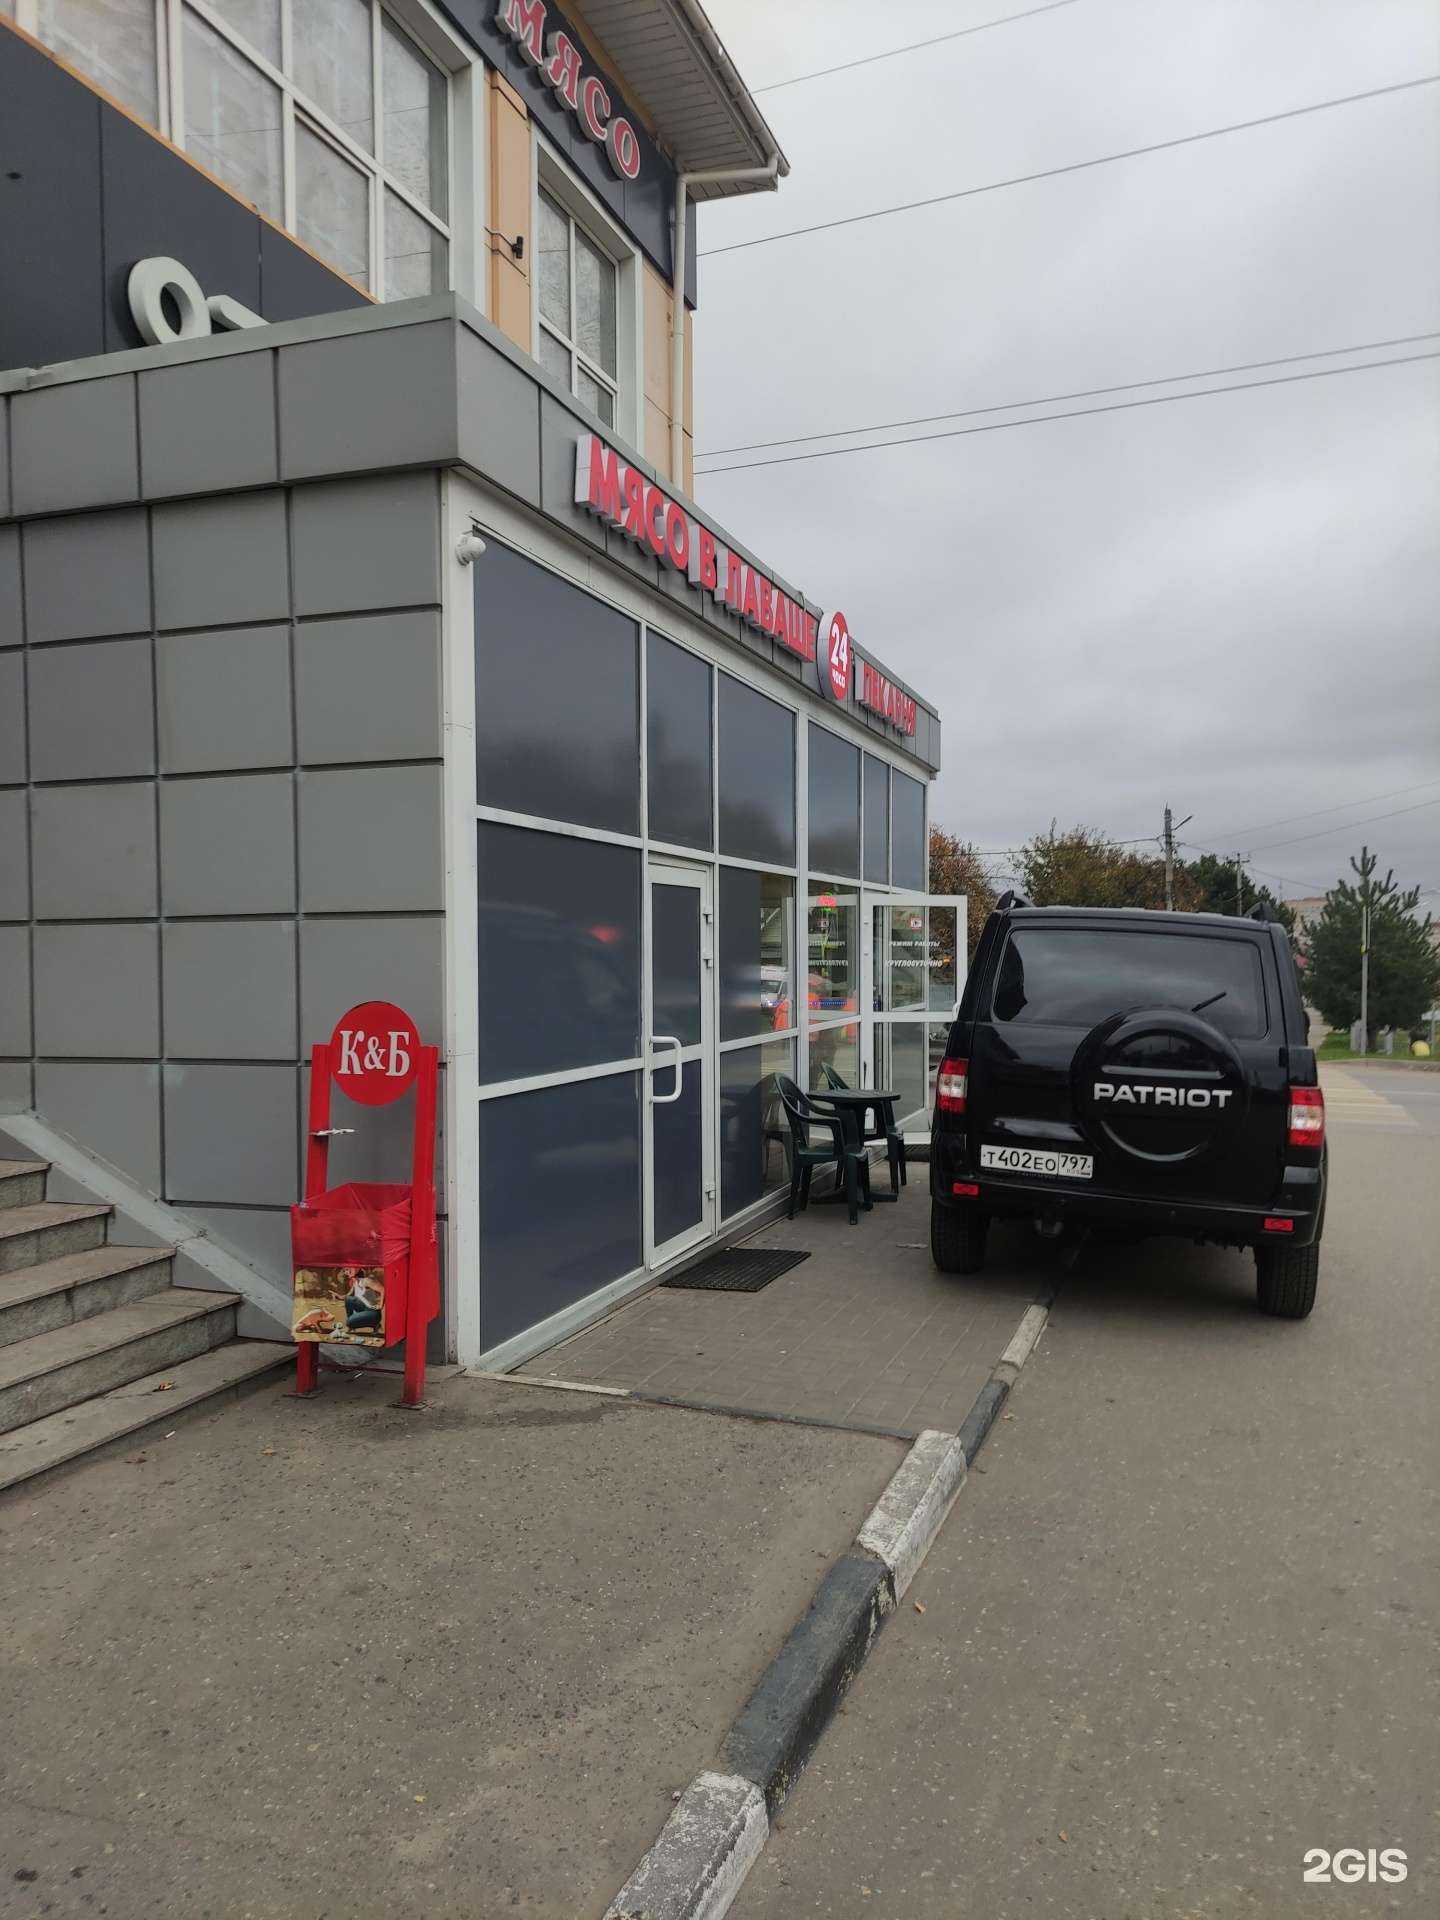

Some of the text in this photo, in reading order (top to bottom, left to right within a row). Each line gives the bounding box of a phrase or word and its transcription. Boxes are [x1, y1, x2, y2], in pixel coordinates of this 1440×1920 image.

[498, 0, 640, 179] МЯСО
[577, 433, 816, 662] МЯСО В ЛАВАШЕ
[831, 622, 848, 672] 24
[338, 1030, 410, 1076] К&Б
[1093, 1082, 1233, 1109] PATRIOT
[1061, 1154, 1088, 1170] 797
